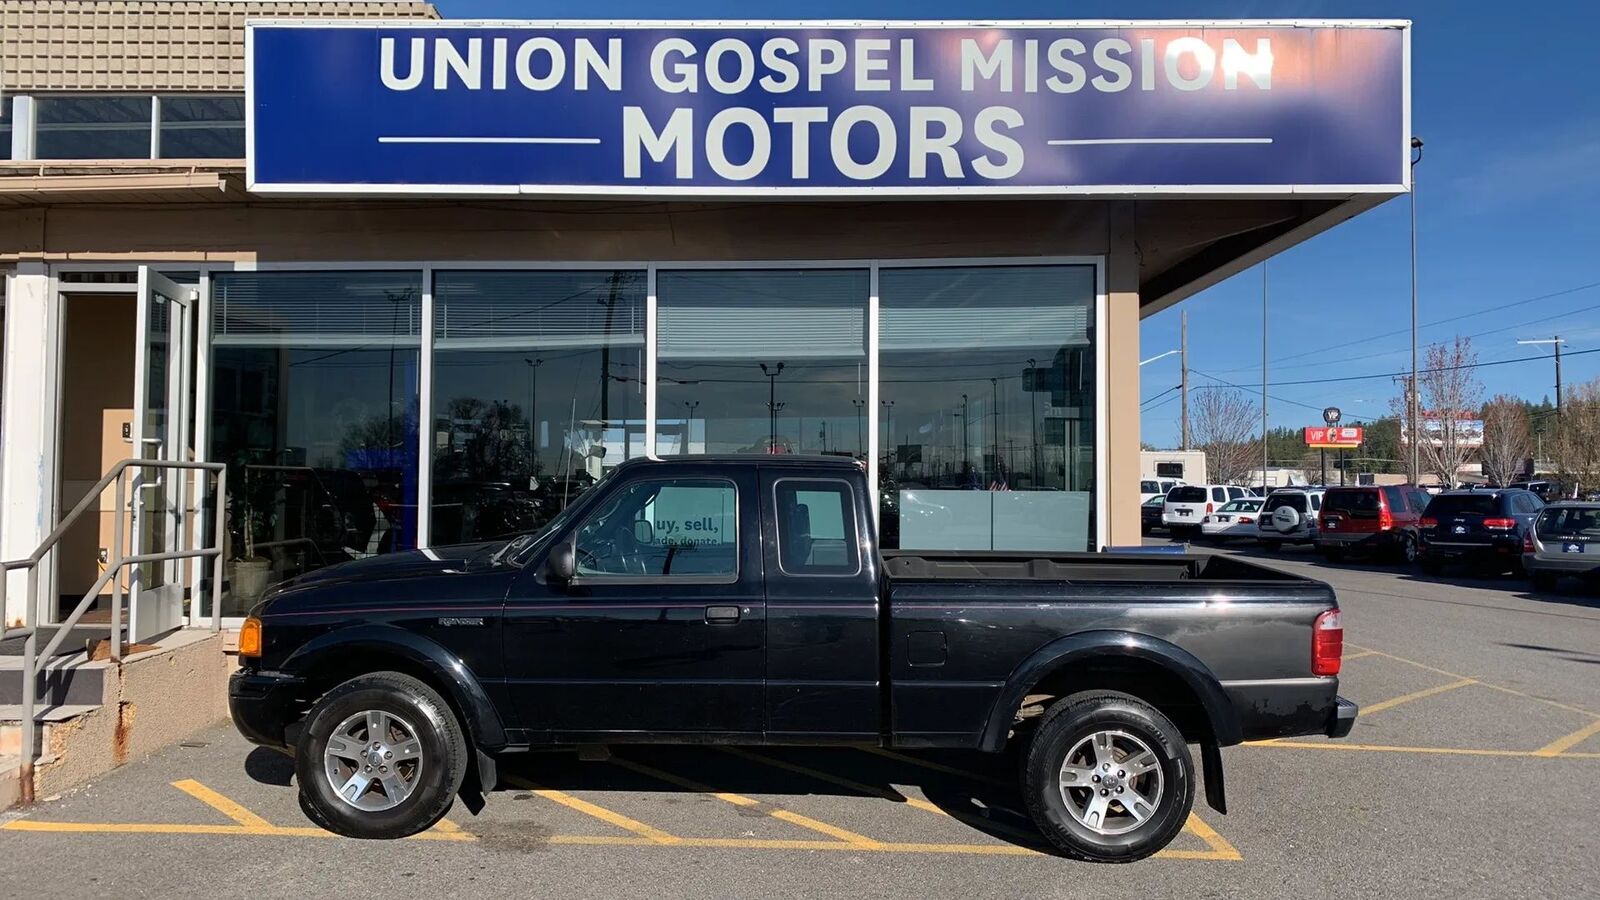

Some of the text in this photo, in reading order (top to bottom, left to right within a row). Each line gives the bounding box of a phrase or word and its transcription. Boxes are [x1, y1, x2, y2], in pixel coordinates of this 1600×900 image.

[380, 37, 1274, 95] UNION GOSPEL MISSION
[623, 105, 1025, 181] MOTORS
[1310, 430, 1324, 441] VIP
[684, 518, 718, 533] sell,
